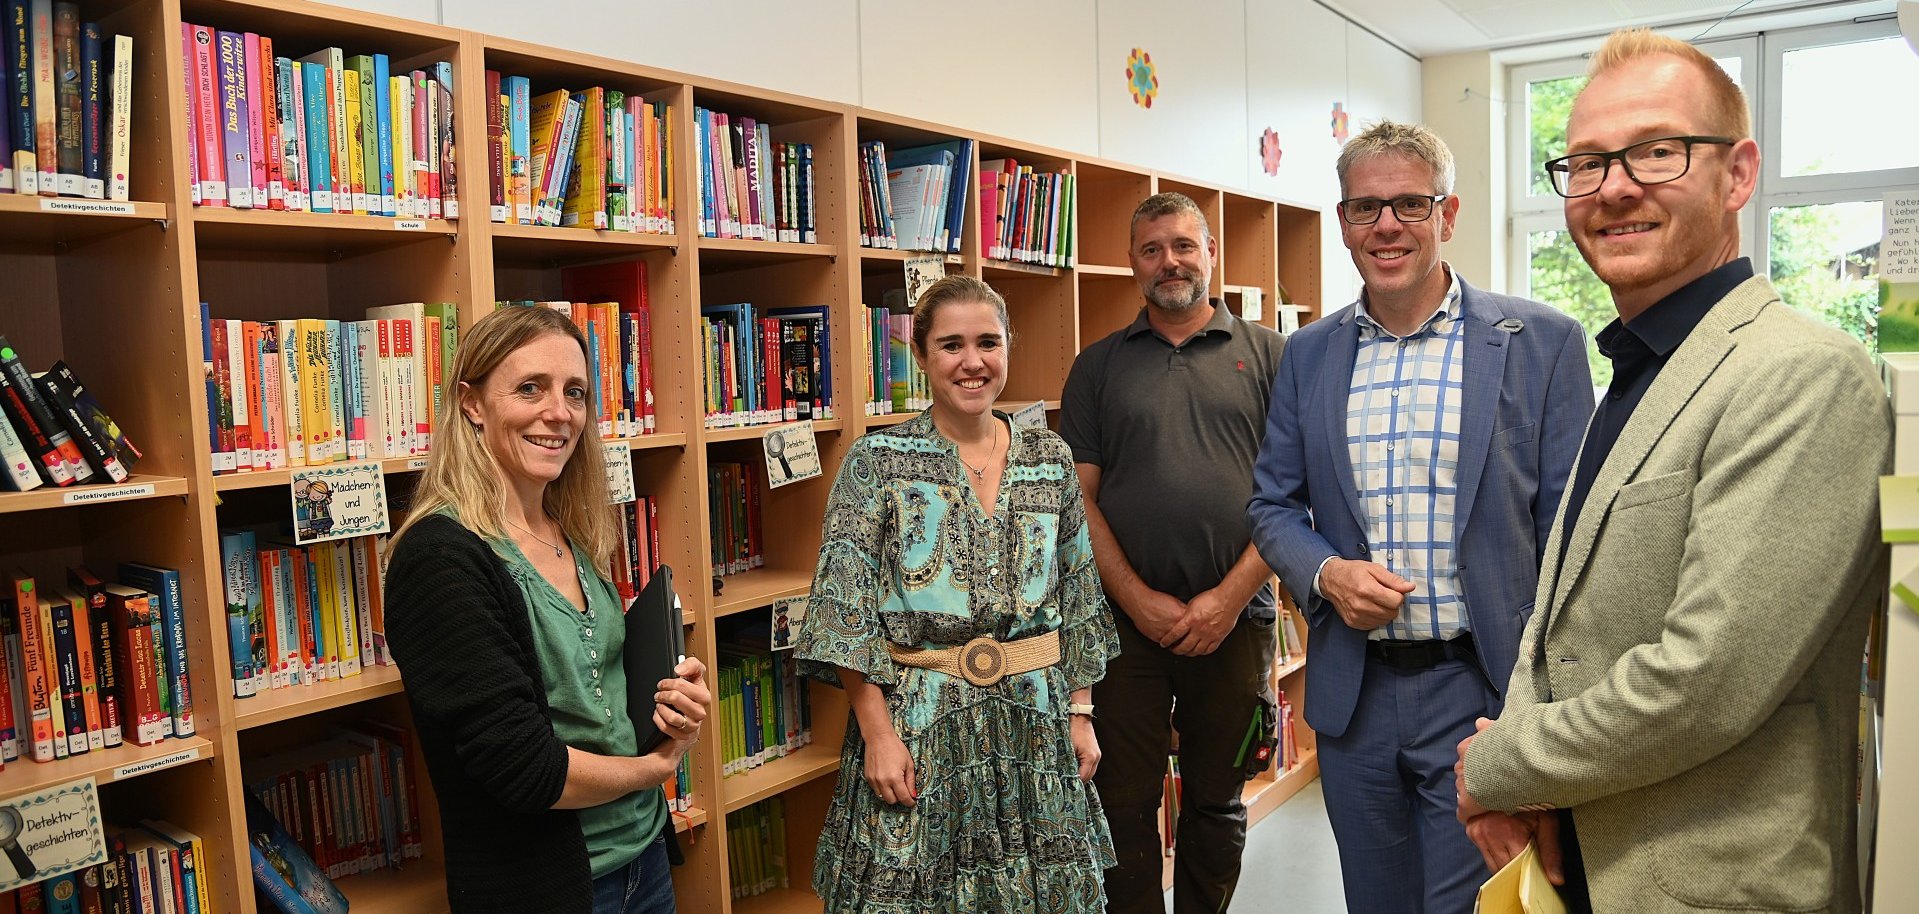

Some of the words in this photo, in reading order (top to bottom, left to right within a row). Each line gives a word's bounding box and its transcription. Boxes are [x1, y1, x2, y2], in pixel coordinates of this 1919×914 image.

[221, 36, 234, 65] 1000
[224, 66, 234, 83] der
[234, 38, 245, 101] Kinderwitze
[226, 85, 236, 110] Buch
[118, 115, 126, 138] Oskar
[227, 112, 238, 133] Das
[748, 136, 758, 191] MADITA
[50, 202, 126, 212] Detektivgeschichten
[1888, 228, 1909, 236] ganz
[73, 488, 146, 501] Detektivgeschichten
[345, 496, 360, 508] und
[340, 515, 370, 528] Jungen
[170, 579, 179, 609] INTERNET
[174, 610, 179, 620] IM
[21, 606, 34, 648] Freunde
[24, 649, 38, 672] Fünf
[33, 676, 46, 710] Blyton
[122, 753, 190, 776] Detektivgeschichten
[26, 809, 81, 832] Detektiv-
[26, 828, 88, 856] geschichten
